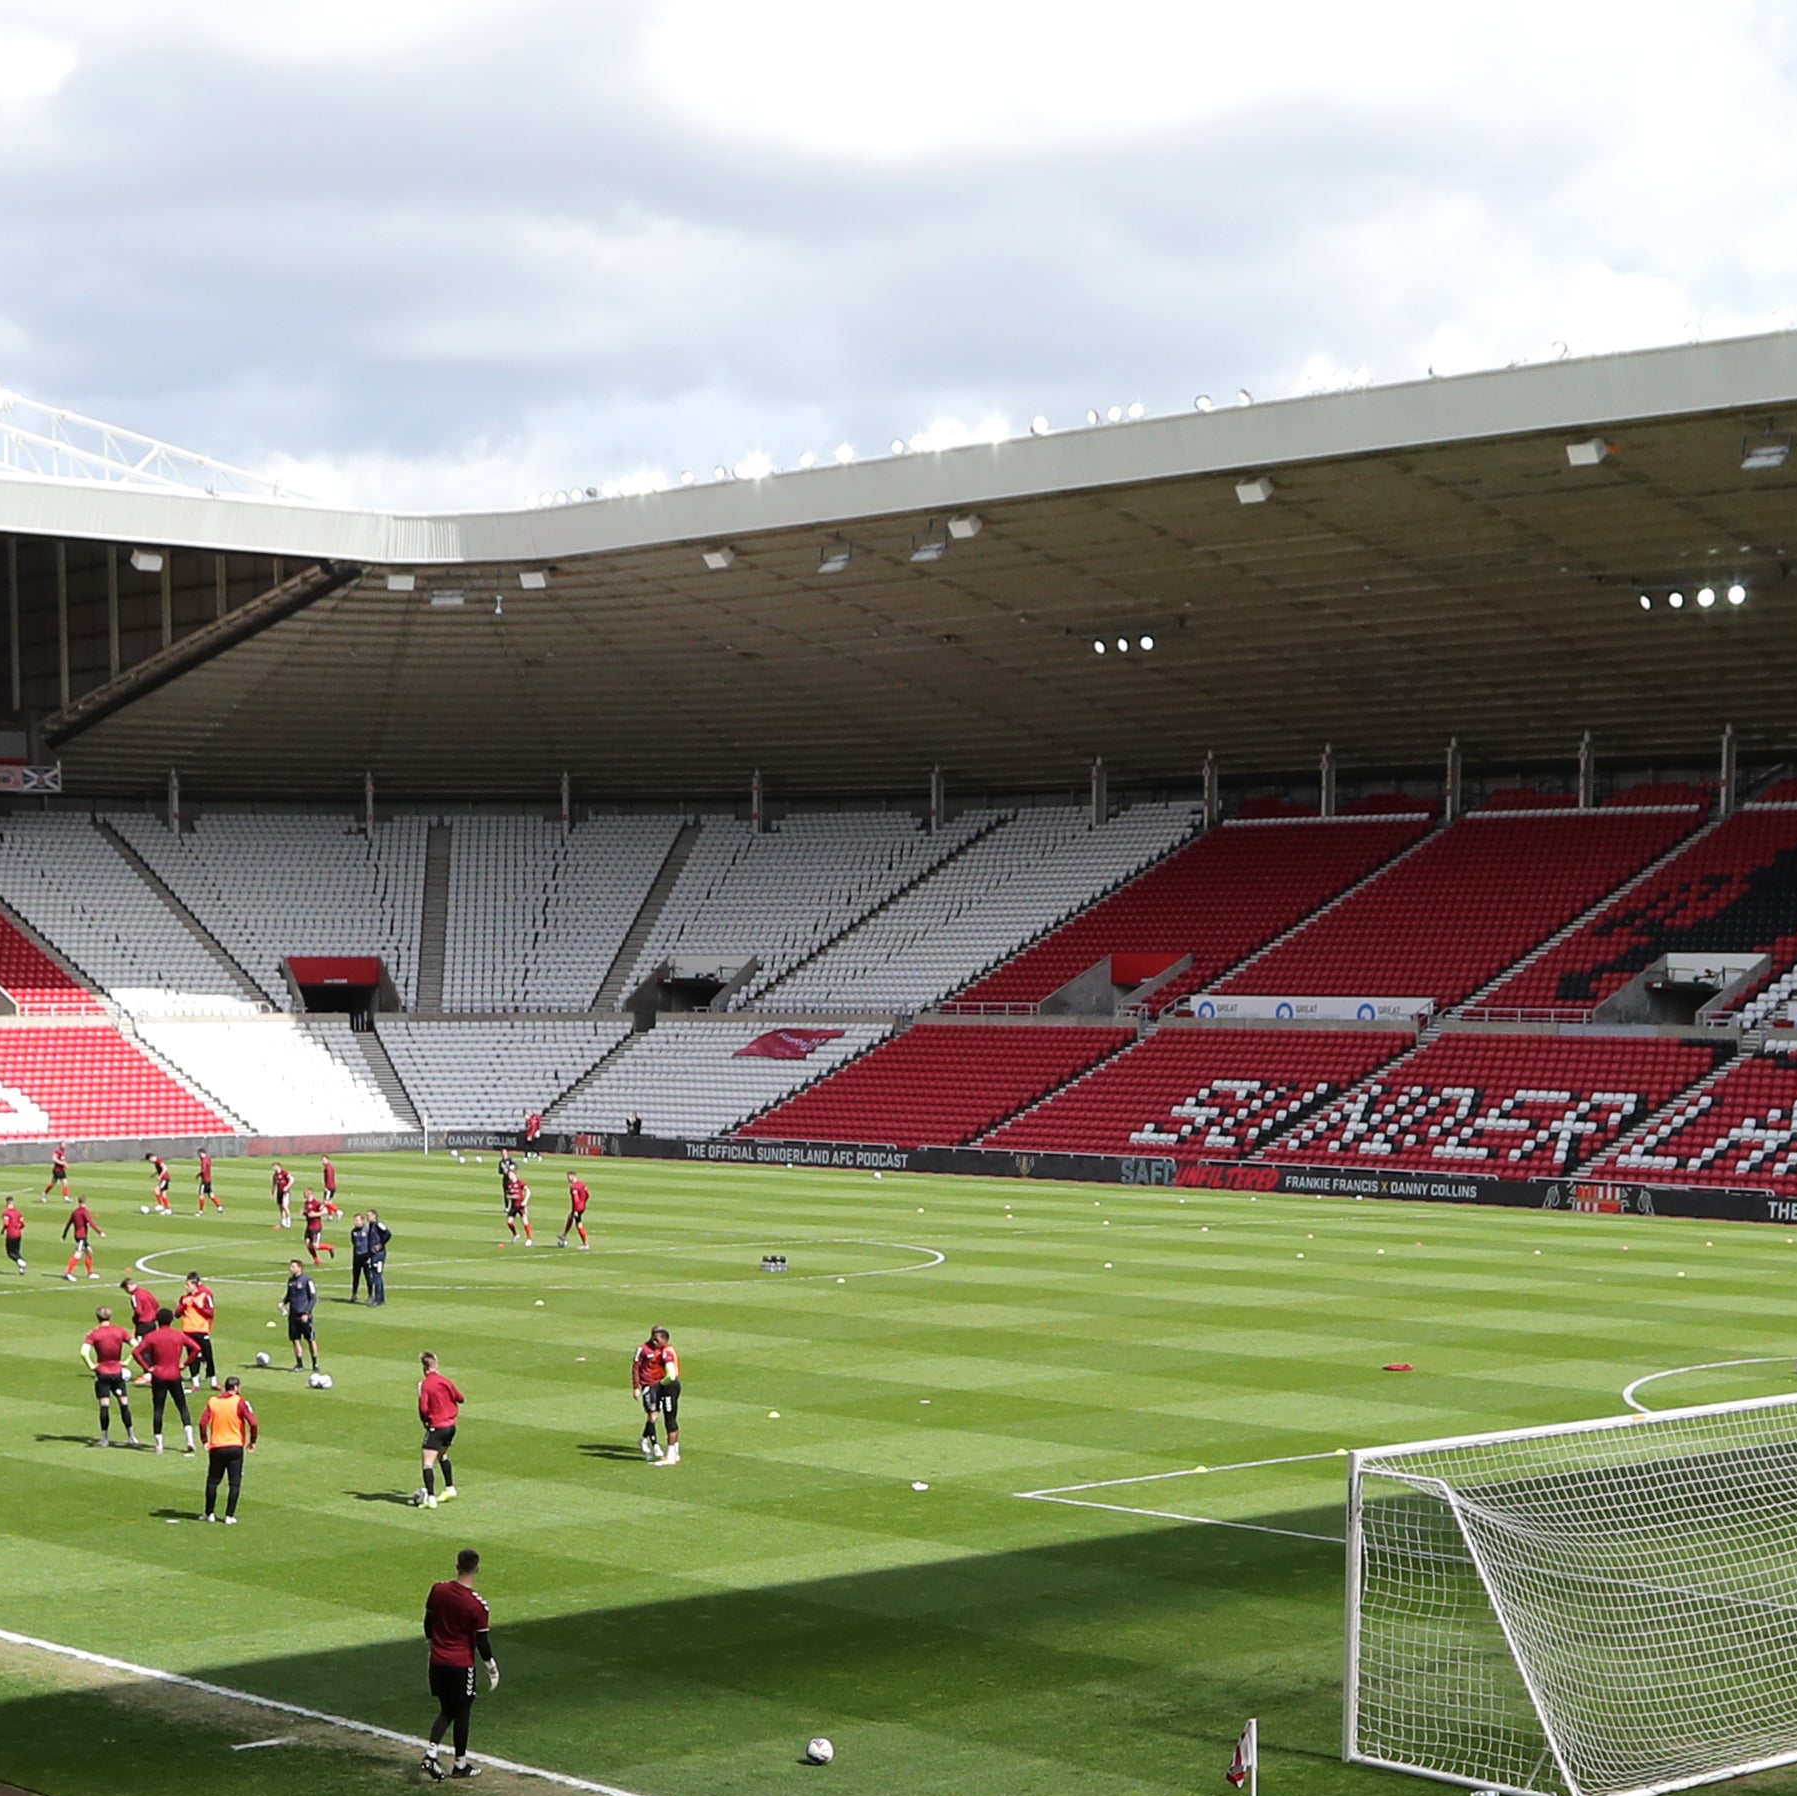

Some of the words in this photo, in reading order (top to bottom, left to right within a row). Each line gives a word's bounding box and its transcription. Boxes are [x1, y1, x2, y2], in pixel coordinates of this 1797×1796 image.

[1216, 1003, 1238, 1013] GREAT
[1296, 1005, 1318, 1014] GREAT
[1378, 1006, 1401, 1015] GREAT
[389, 1134, 435, 1147] FRANCS
[448, 1135, 484, 1147] DANNY
[686, 1143, 705, 1158] THE
[708, 1145, 754, 1160] OFFICIAL
[756, 1147, 829, 1165] SUNDERLAND
[832, 1151, 853, 1166] AFC
[856, 1151, 908, 1168] PODCAST
[1121, 1160, 1177, 1186] SAFC
[1174, 1164, 1281, 1191] UNFILTERED
[1285, 1175, 1331, 1191] FRANKIE
[1333, 1177, 1379, 1193] FRANCIS
[1391, 1182, 1428, 1196] DANNY
[1431, 1184, 1477, 1199] COLLINS
